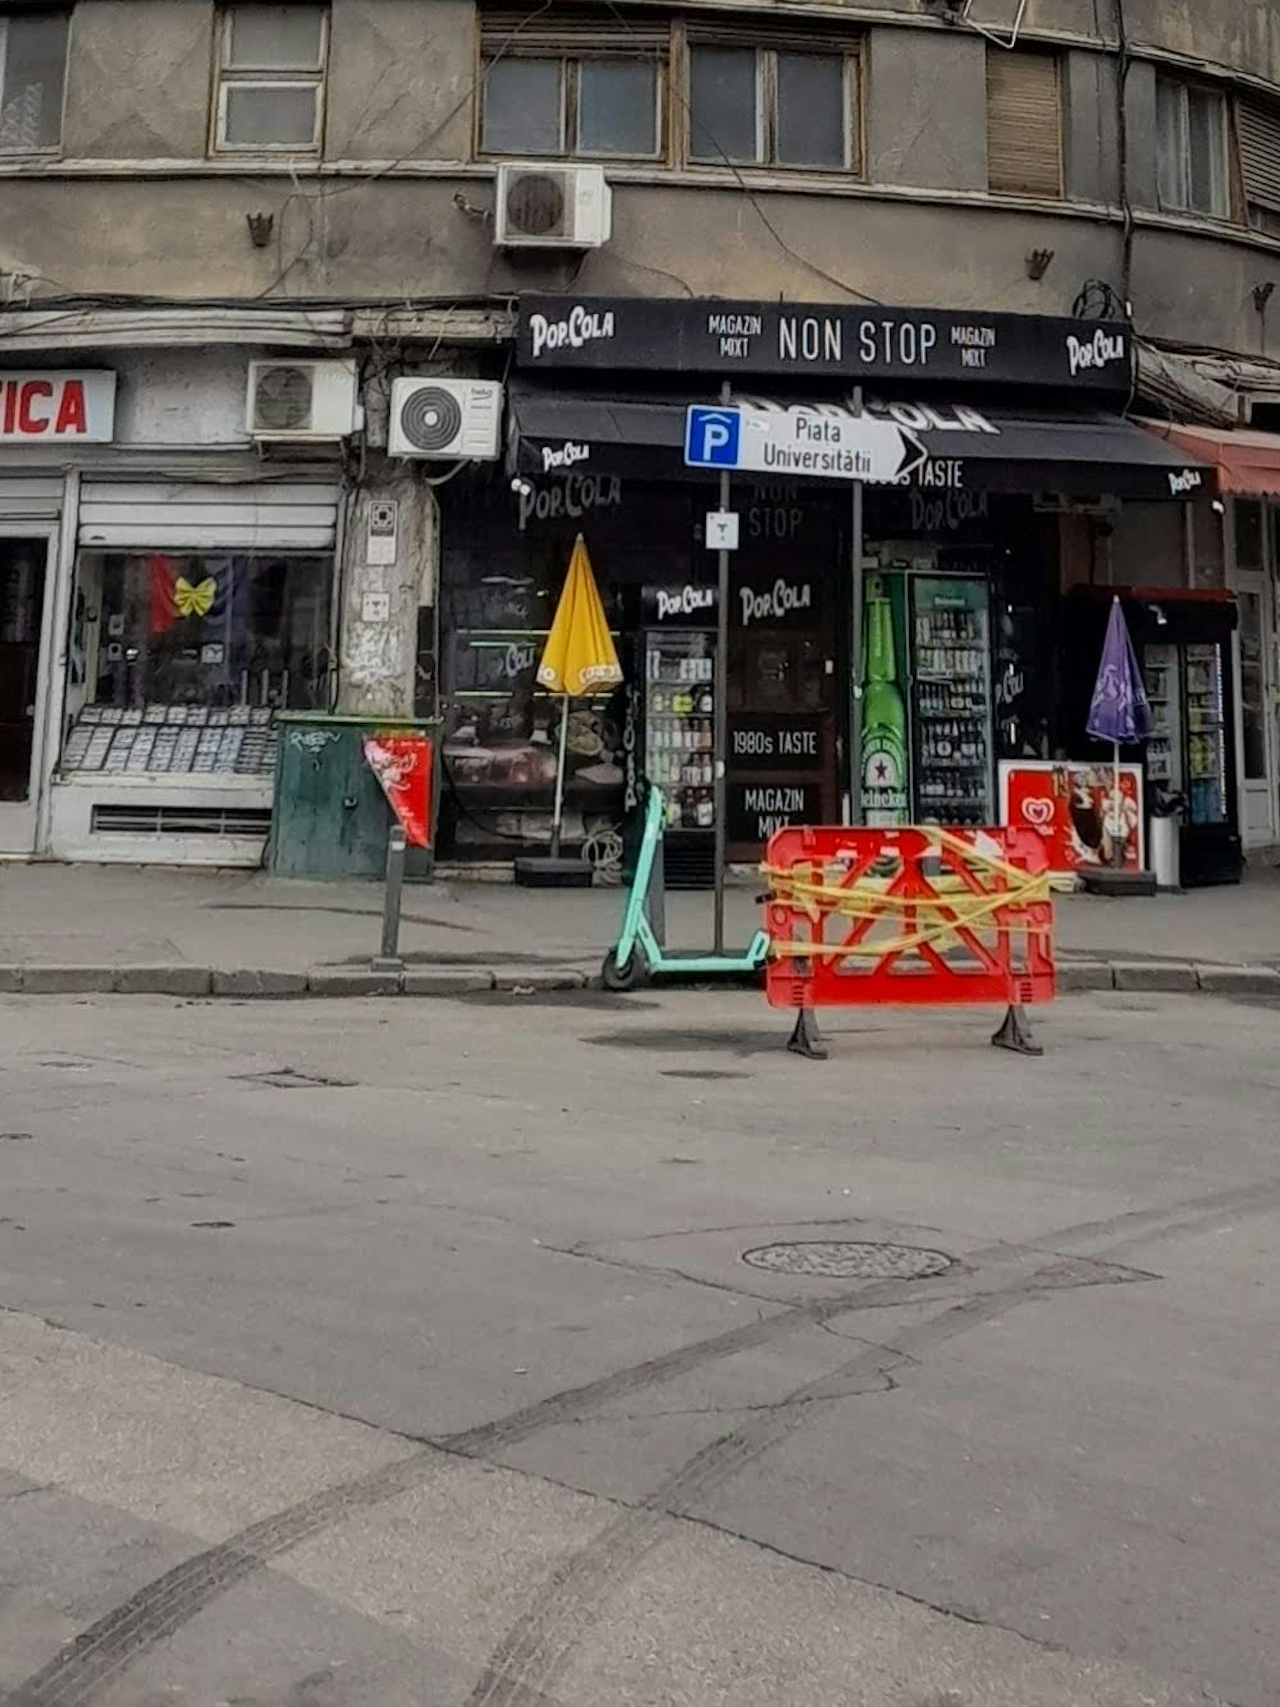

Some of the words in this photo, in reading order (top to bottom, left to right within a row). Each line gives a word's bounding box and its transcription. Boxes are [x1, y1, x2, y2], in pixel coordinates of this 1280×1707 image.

[709, 315, 761, 335] MAGAZIN
[779, 318, 841, 361] NON
[860, 321, 936, 364] STOP
[951, 326, 995, 347] MAGAZIN
[720, 338, 748, 358] MIXT
[961, 348, 987, 368] MIXT
[749, 507, 803, 537] STOP
[733, 731, 773, 754] 1980s
[778, 731, 817, 755] TASTE
[745, 789, 804, 812] MAGAZIN
